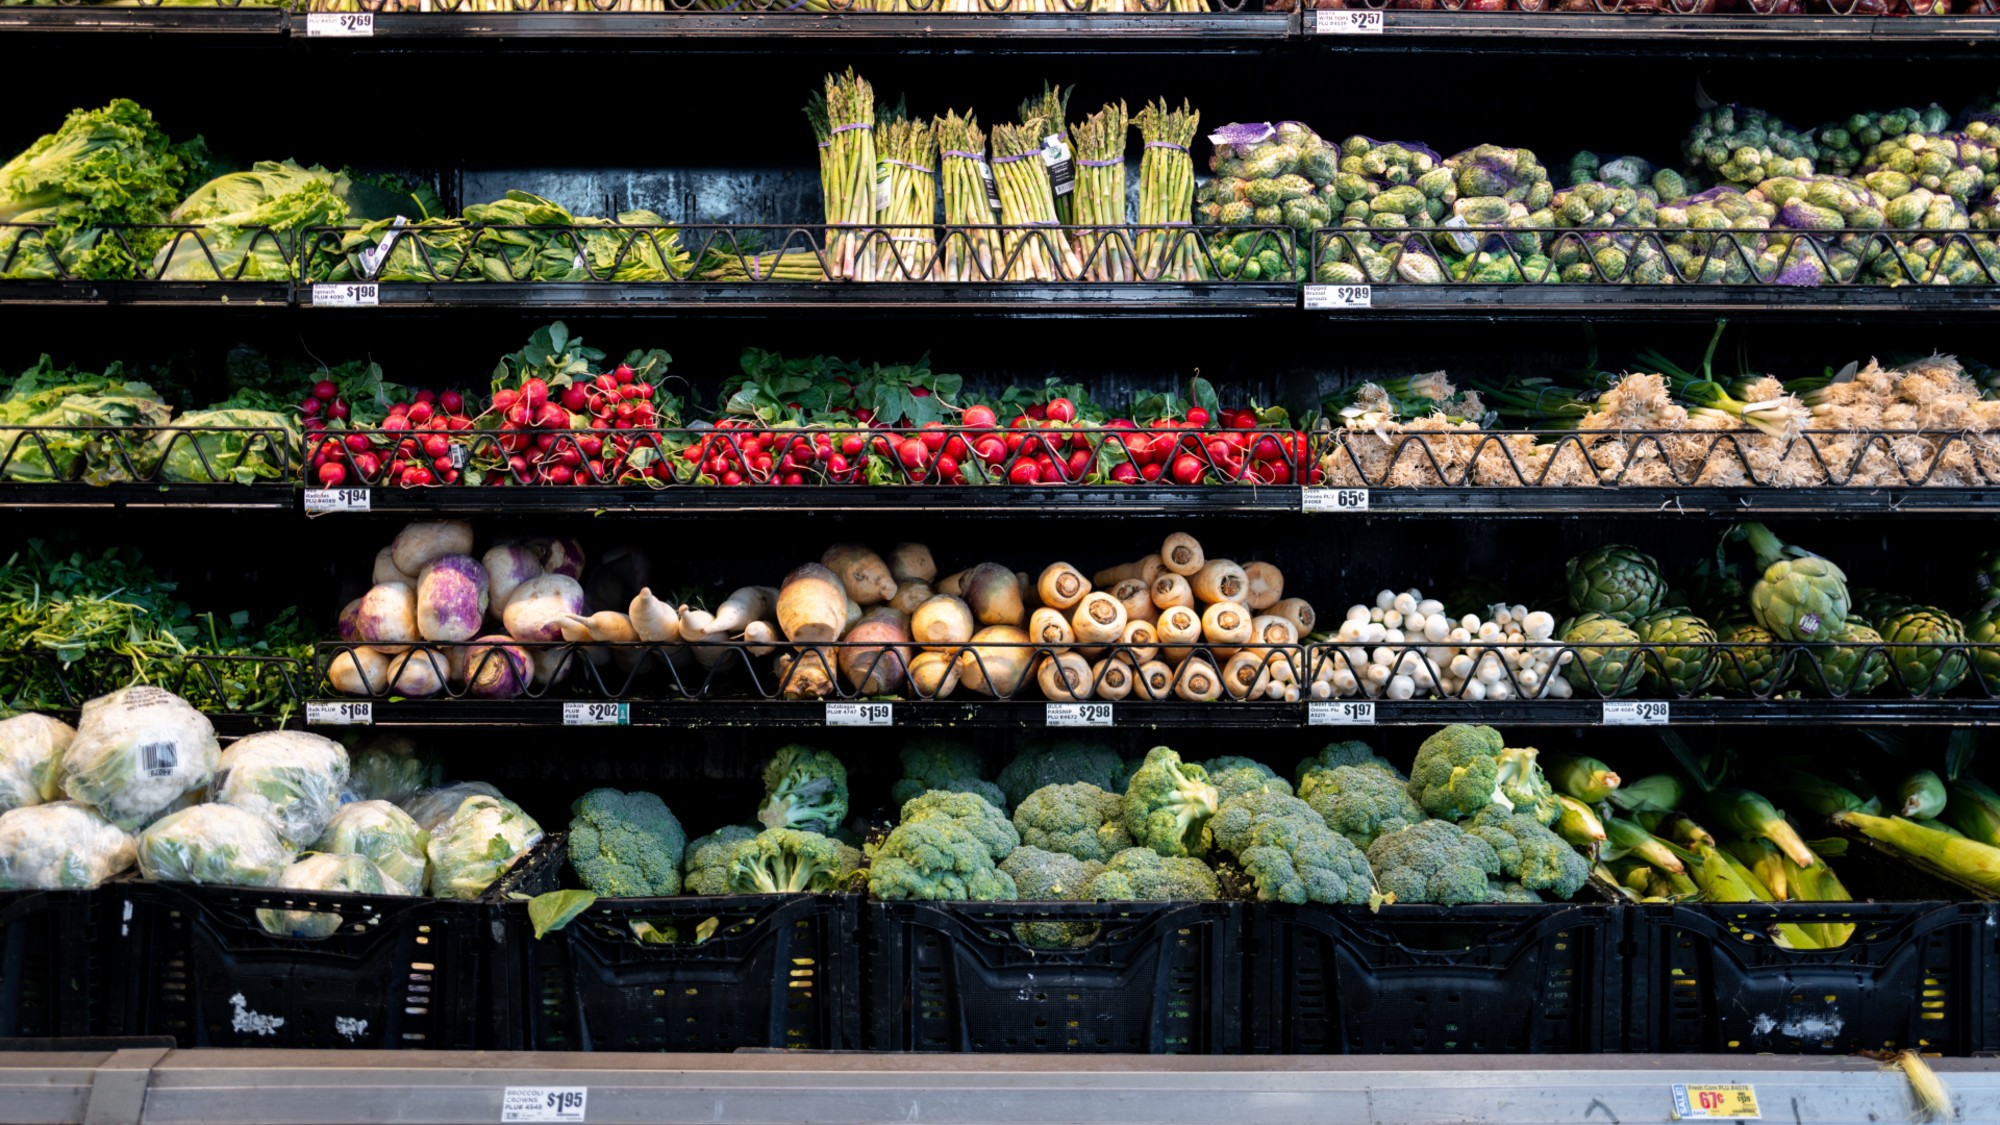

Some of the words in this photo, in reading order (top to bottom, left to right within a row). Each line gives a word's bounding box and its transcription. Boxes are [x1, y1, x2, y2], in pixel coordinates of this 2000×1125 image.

[340, 15, 371, 30] $269
[1351, 13, 1380, 28] $257
[347, 286, 375, 301] $198
[1338, 287, 1369, 302] $289
[339, 490, 366, 505] $194
[1338, 491, 1365, 506] 65¢
[341, 704, 368, 719] $168
[589, 704, 617, 720] $202
[860, 706, 888, 721] $159
[1080, 706, 1110, 721] $298
[1344, 704, 1371, 719] $197
[1637, 704, 1666, 719] $298
[547, 1092, 582, 1112] $195
[1699, 1092, 1724, 1109] 67¢
